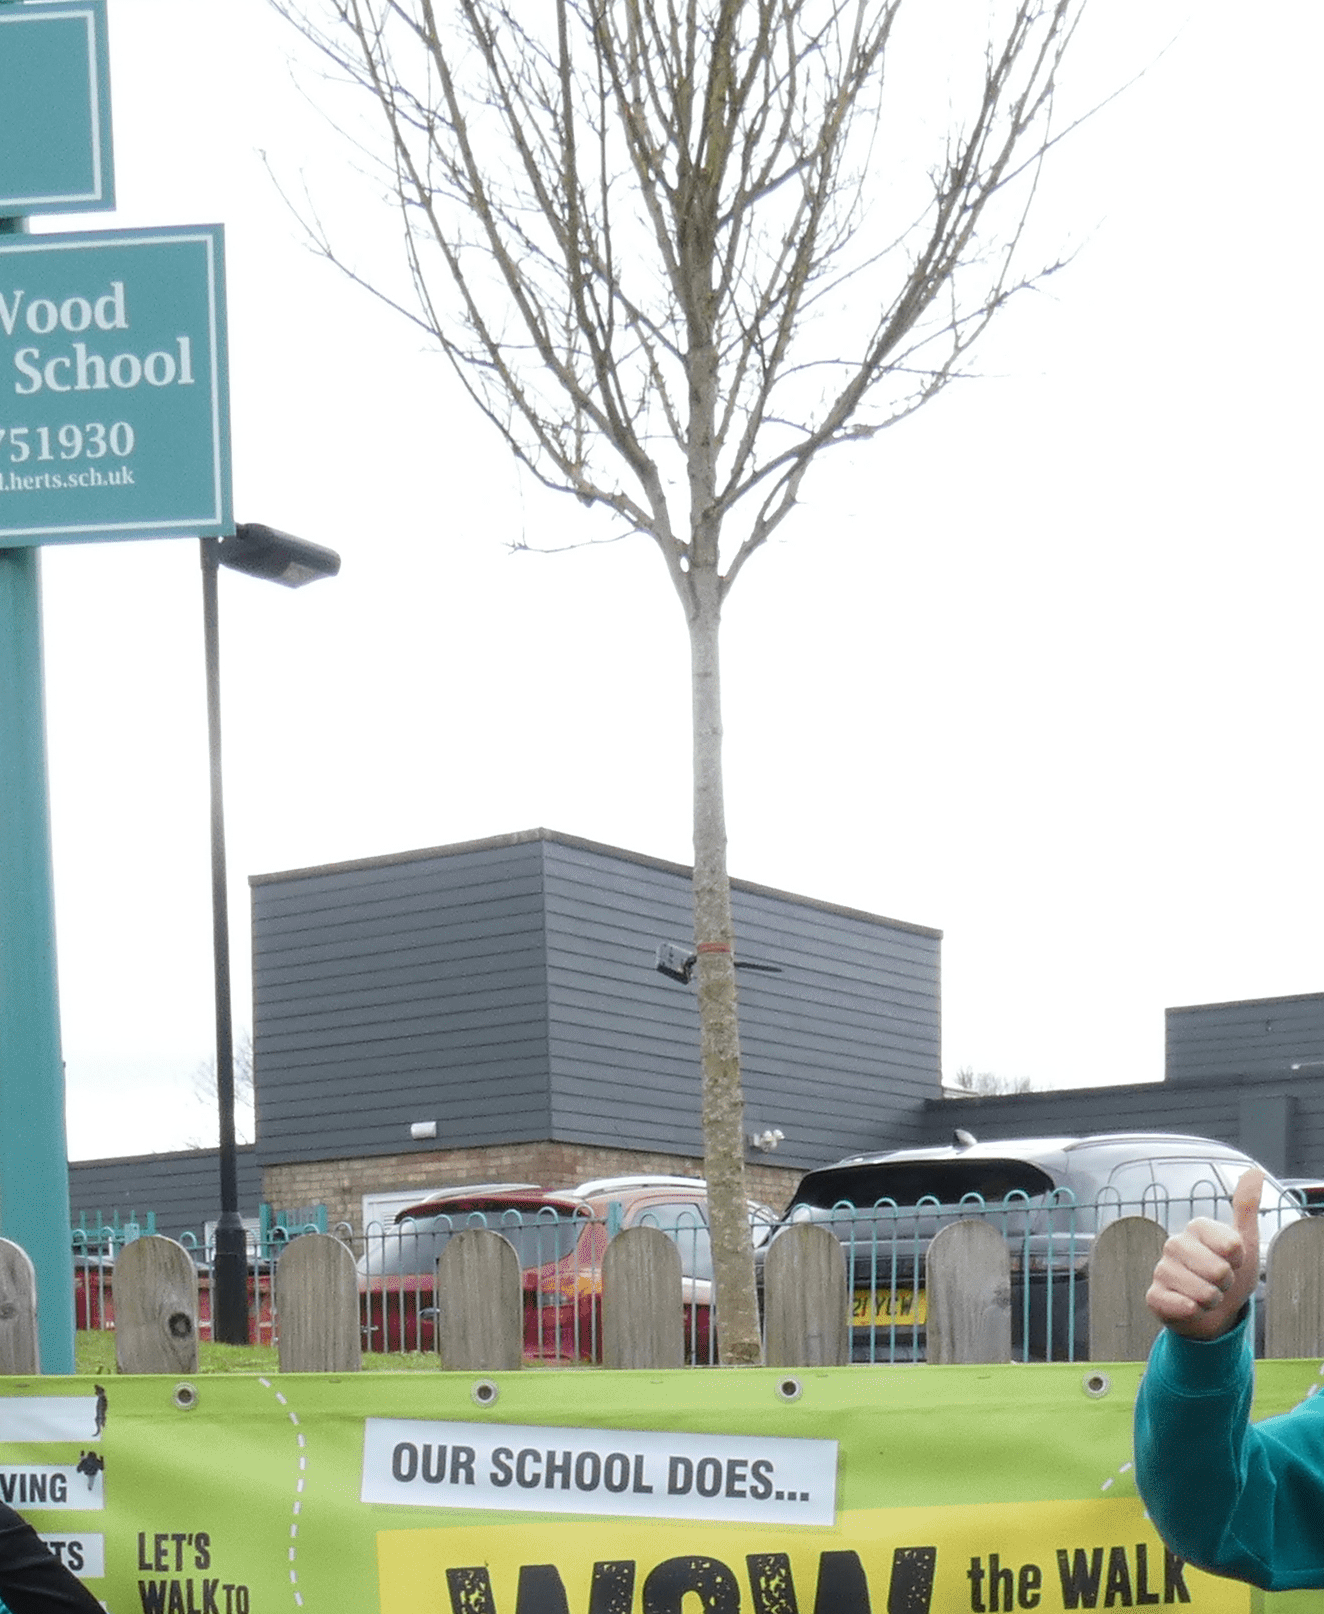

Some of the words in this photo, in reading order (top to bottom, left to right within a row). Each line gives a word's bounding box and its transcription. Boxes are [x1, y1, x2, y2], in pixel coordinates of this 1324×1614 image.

[14, 337, 195, 396] School
[390, 1442, 476, 1485] OUR
[489, 1447, 657, 1493] SCHOOL
[666, 1456, 810, 1503] DOES...
[138, 1532, 210, 1572] LET'S
[967, 1556, 1040, 1613] the
[1056, 1543, 1191, 1610] WALK
